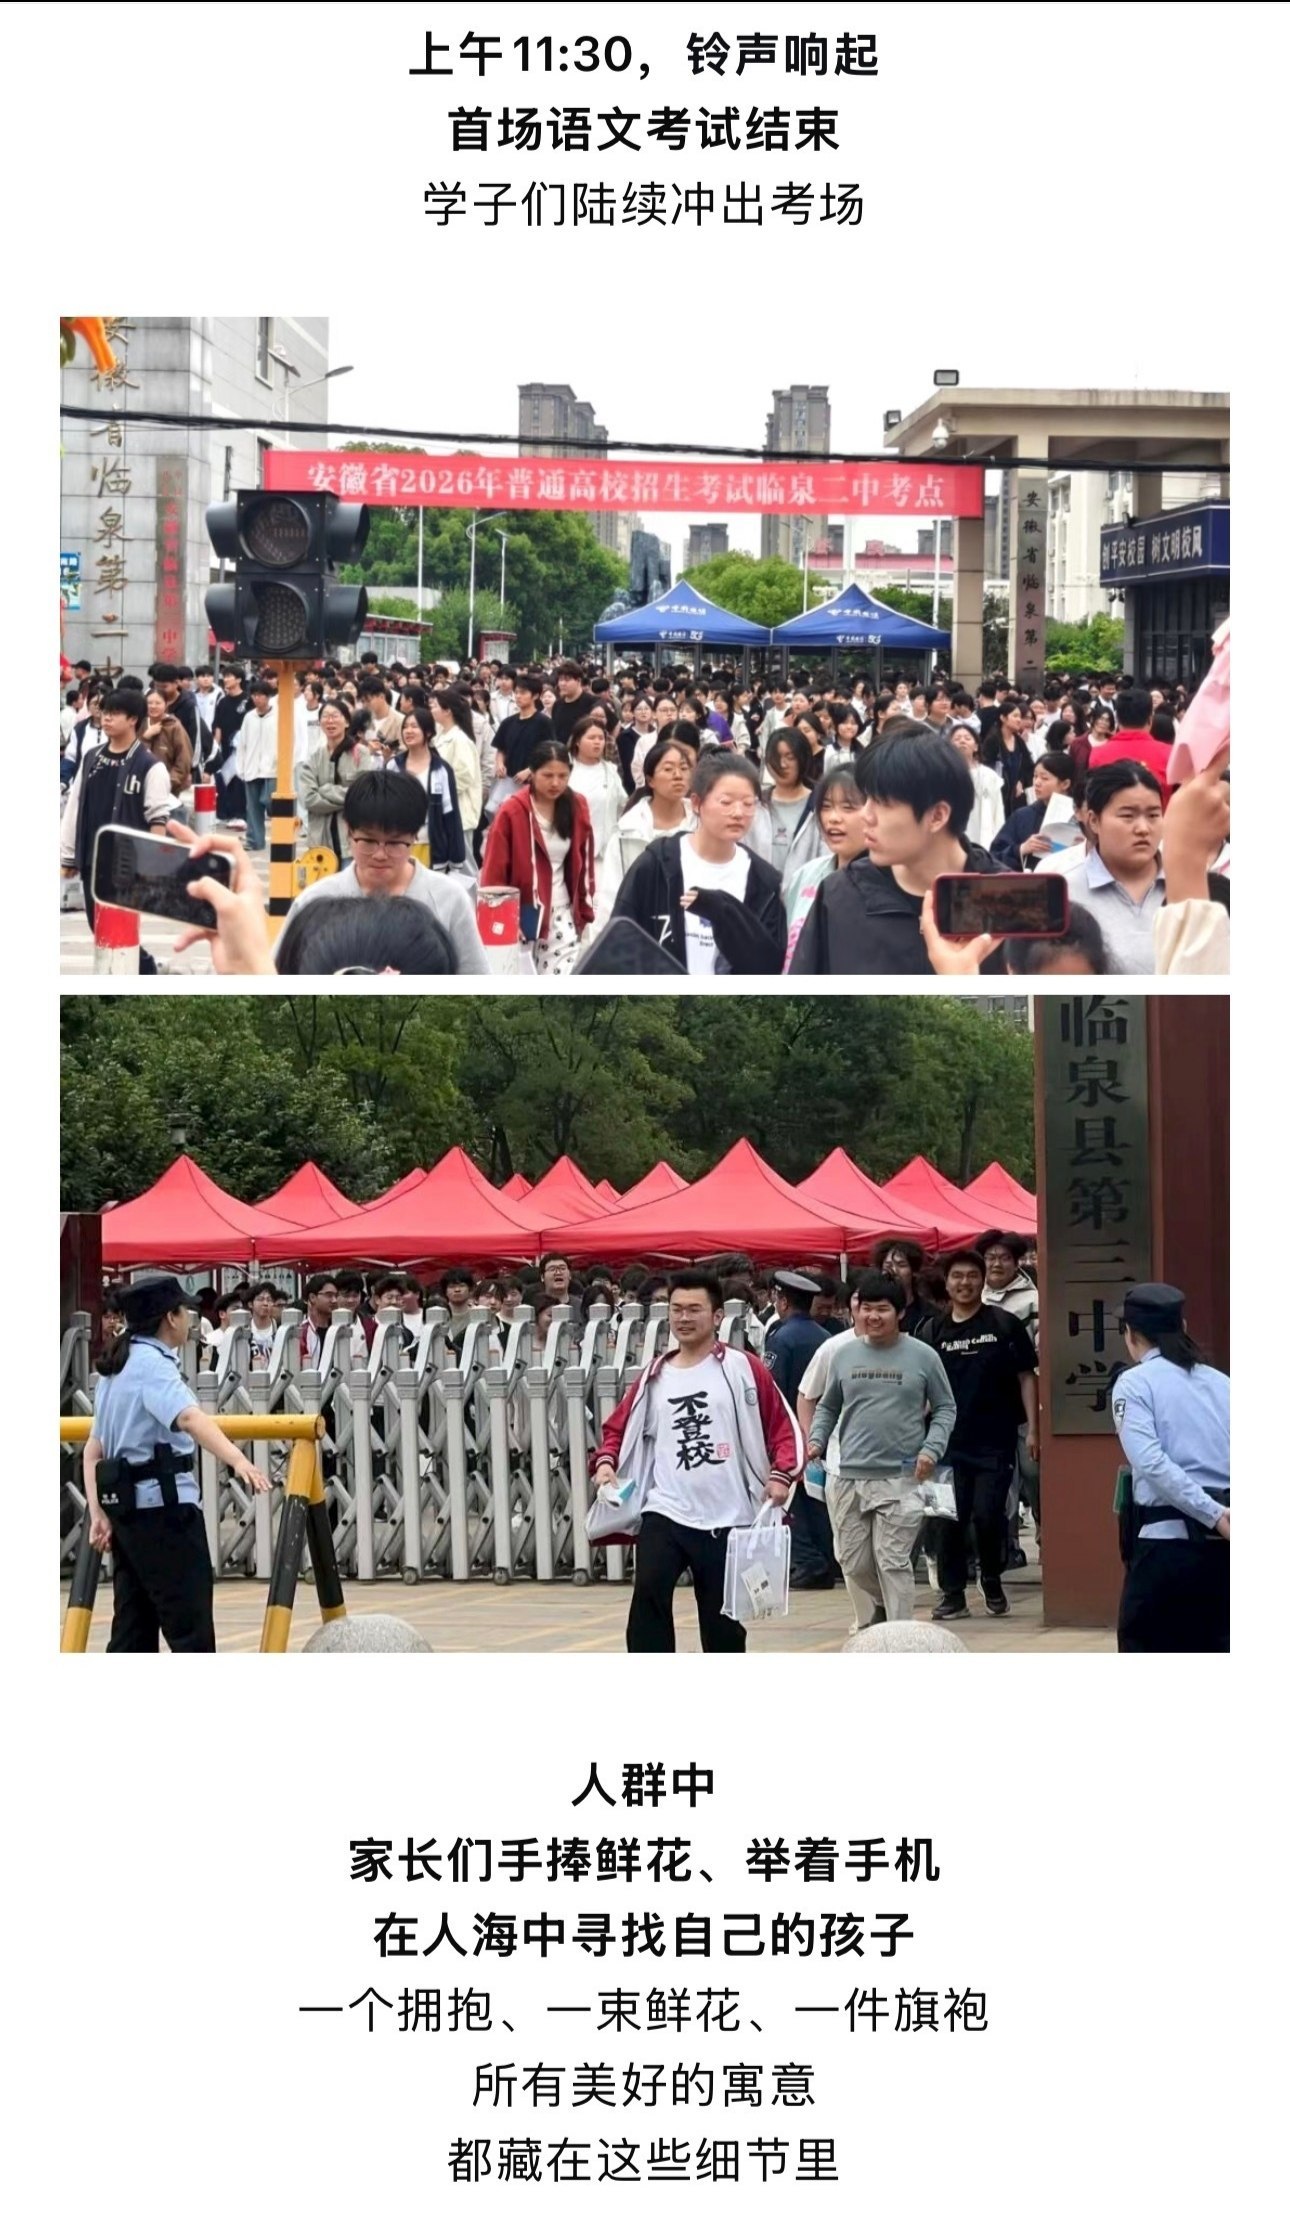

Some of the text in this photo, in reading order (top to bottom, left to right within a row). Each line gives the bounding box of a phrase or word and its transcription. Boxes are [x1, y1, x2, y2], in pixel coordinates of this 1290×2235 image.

[307, 462, 946, 509] 安徽省2026年普通高校招生考试临泉二中考点
[1151, 524, 1203, 564] 树文明校风
[1060, 995, 1134, 1413] 临泉县第三中学
[667, 1391, 726, 1471] 不登校
